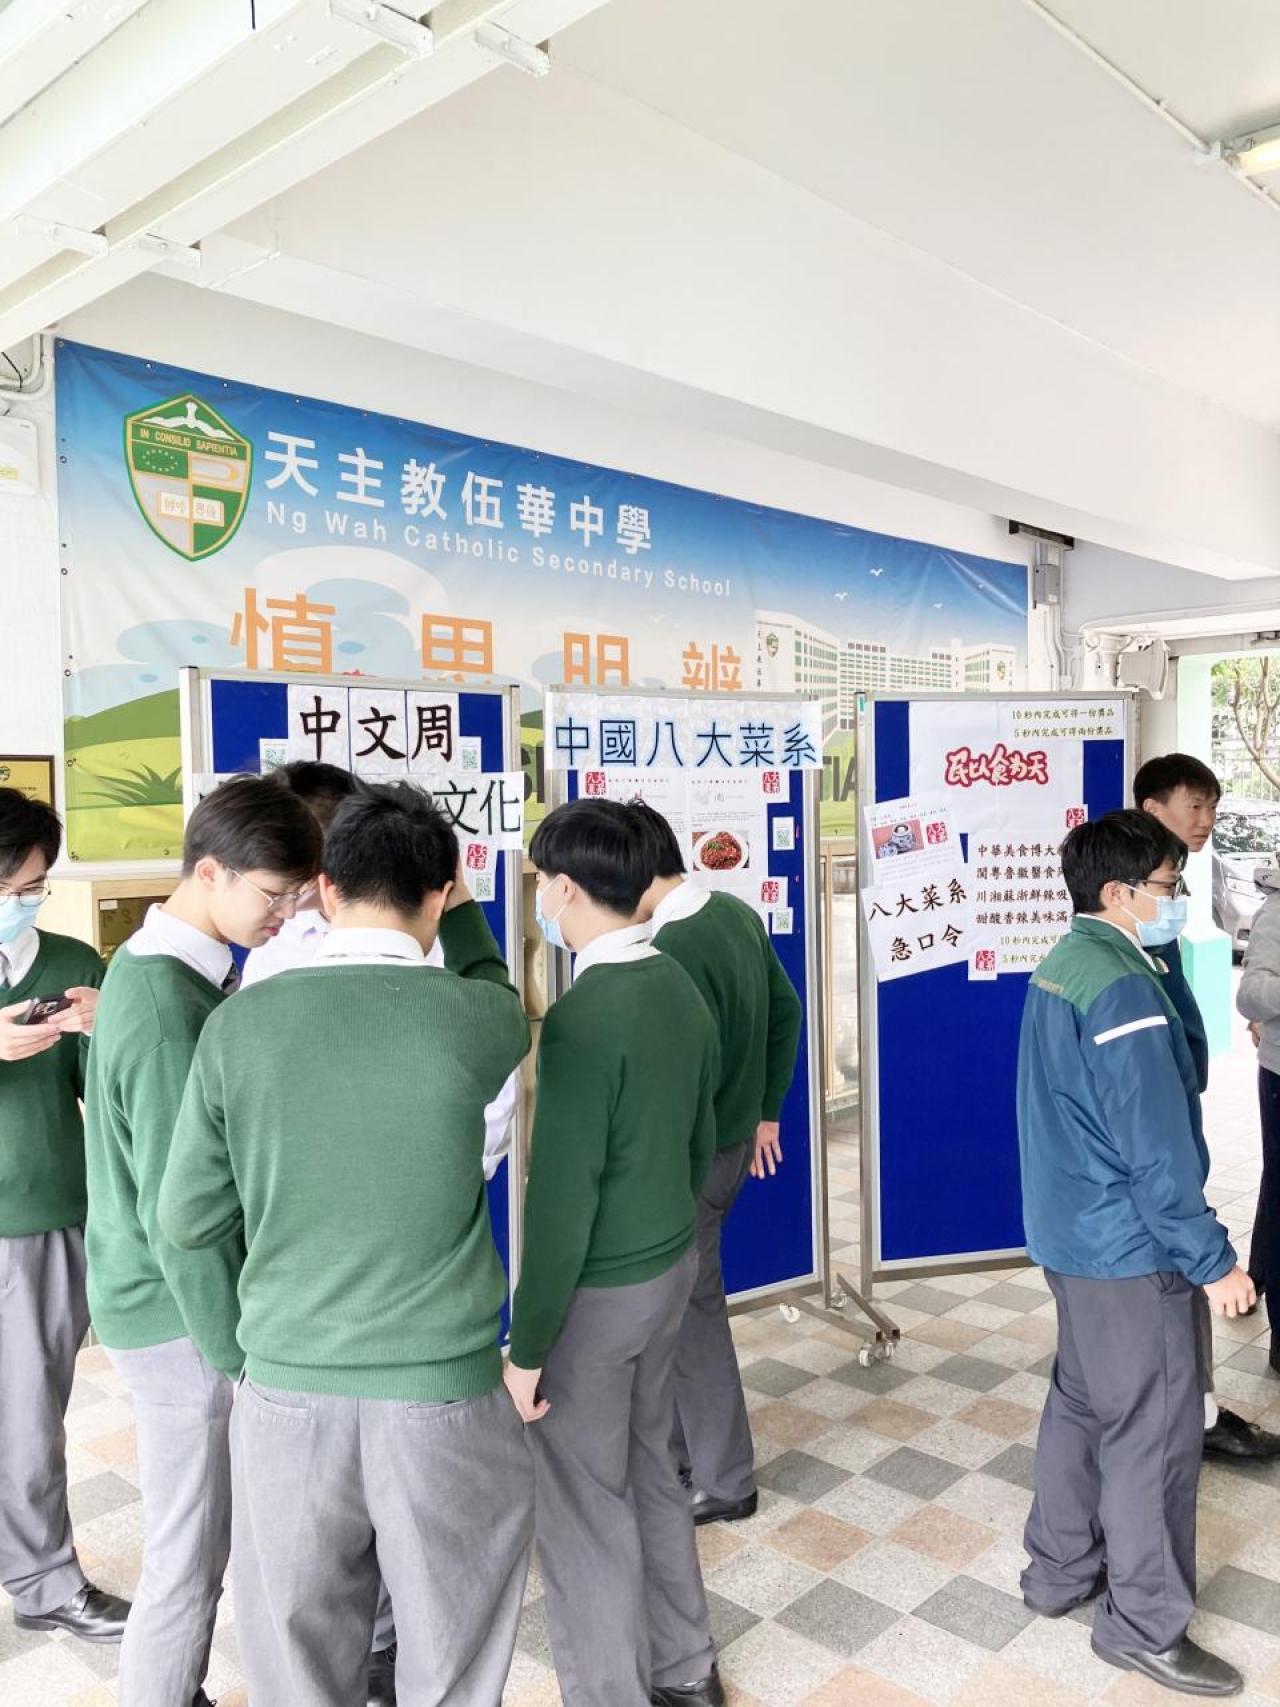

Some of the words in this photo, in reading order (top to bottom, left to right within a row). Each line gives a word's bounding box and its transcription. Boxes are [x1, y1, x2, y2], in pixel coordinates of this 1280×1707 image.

[264, 431, 652, 555] 天主教伍華中學
[267, 502, 307, 534] Ng
[325, 511, 387, 542] Wah
[404, 525, 520, 563] Catholic
[532, 547, 654, 589] Secondary
[664, 570, 731, 597] School
[300, 696, 453, 762] 中文周
[1012, 709, 1022, 720] 10
[556, 717, 817, 767] 中國八大菜系
[869, 879, 967, 920] 八大菜系
[976, 910, 1072, 925] 甜酸香辣美味滿
[891, 924, 964, 962] 急口令
